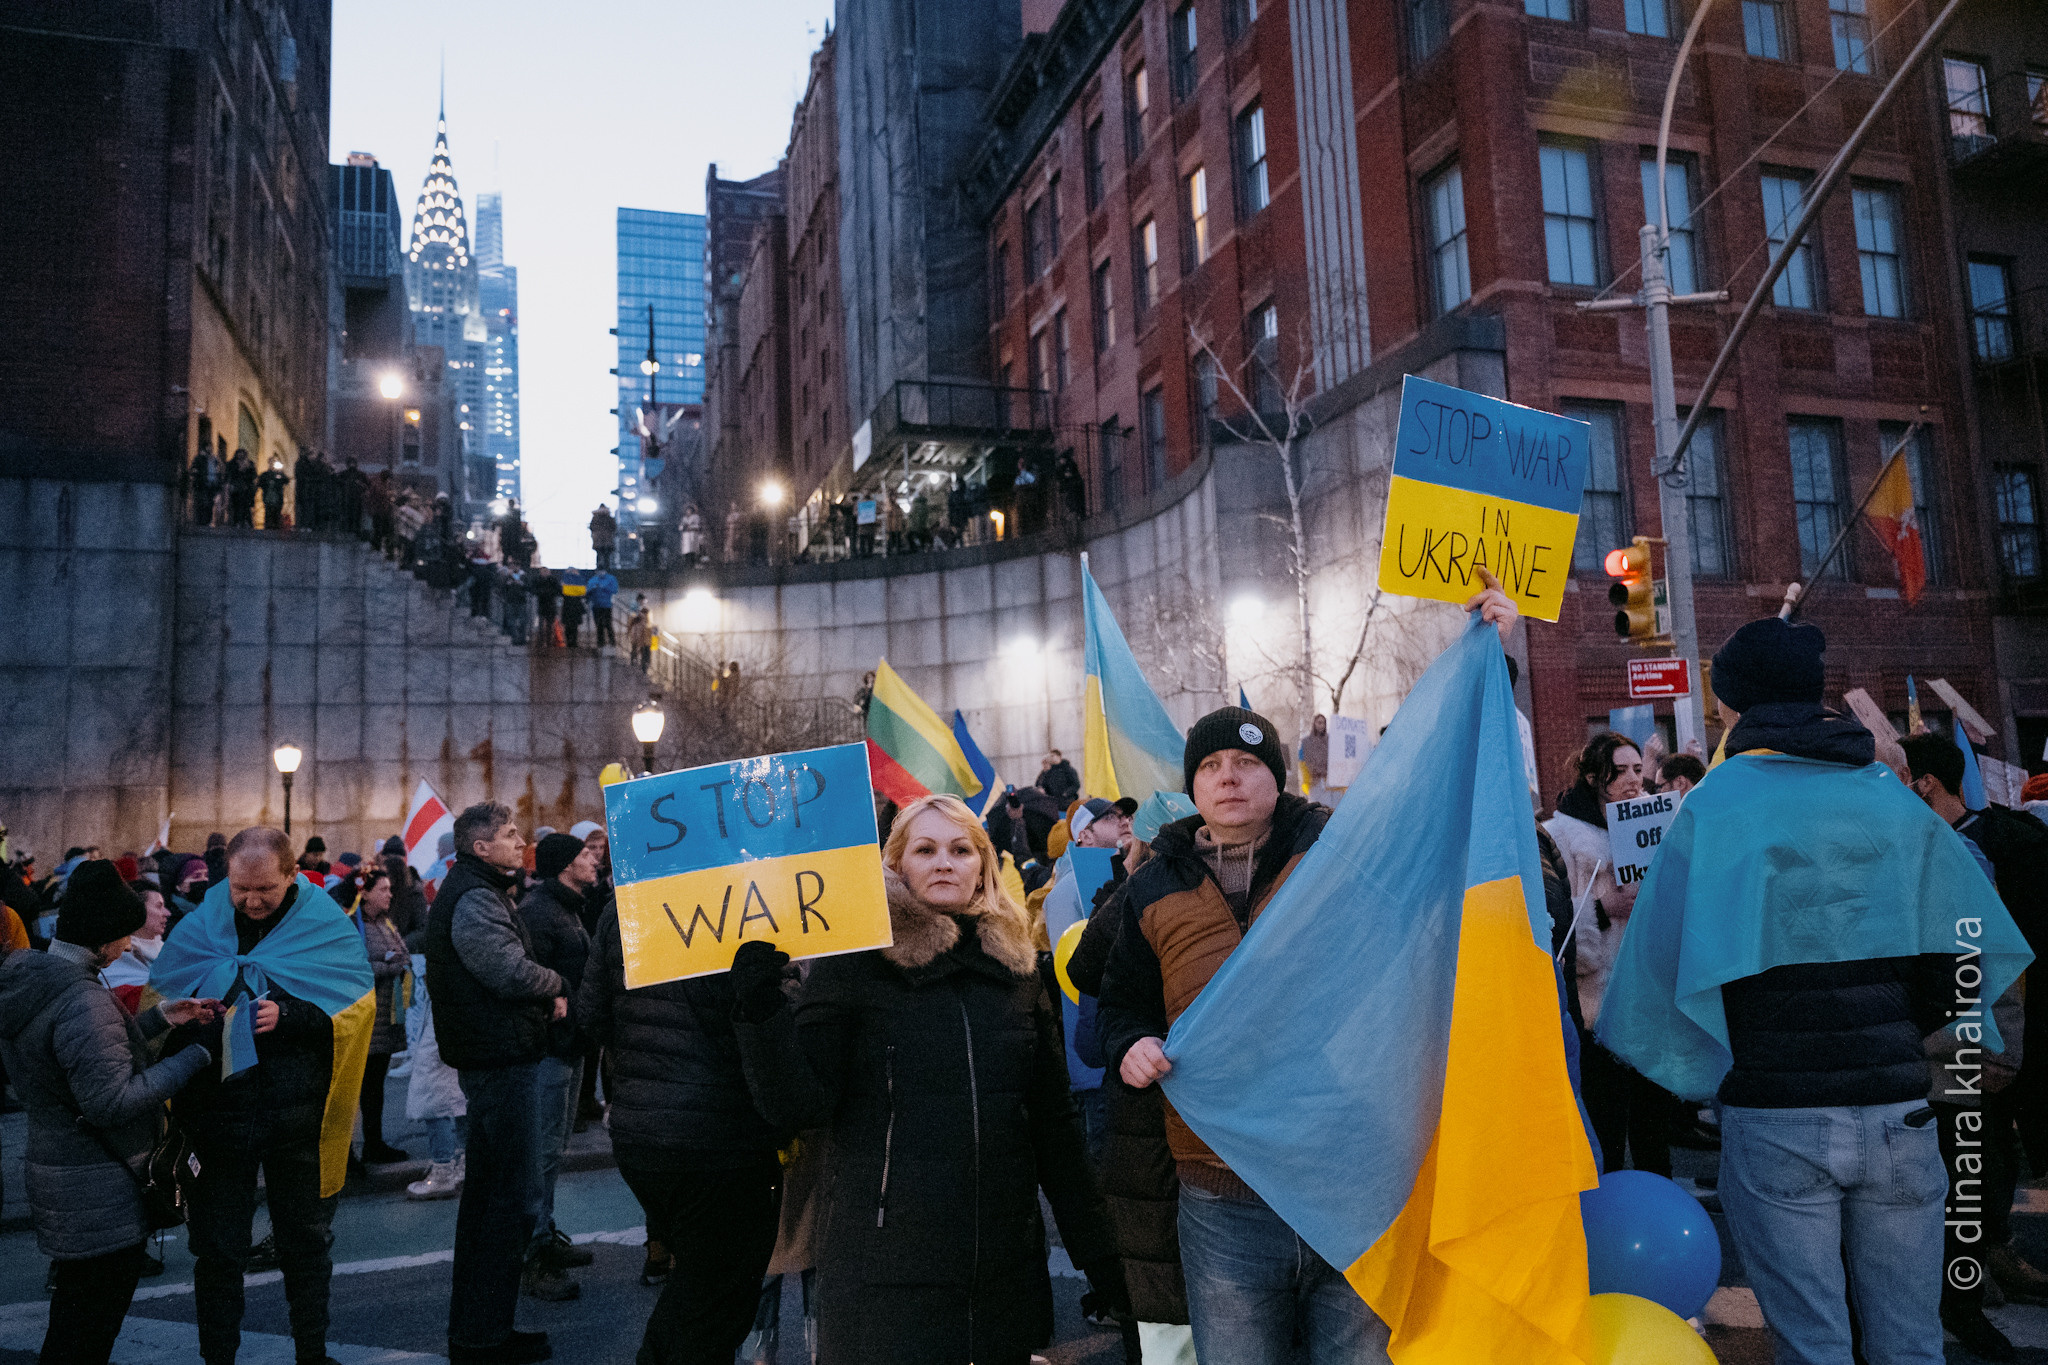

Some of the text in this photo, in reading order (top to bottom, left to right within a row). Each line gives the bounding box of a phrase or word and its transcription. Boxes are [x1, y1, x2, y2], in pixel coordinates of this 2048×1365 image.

[1410, 399, 1572, 491] STOP WAR
[1481, 506, 1510, 538] IN
[1398, 523, 1552, 598] UKRAINE
[1631, 661, 1680, 672] NO STANDING
[1632, 672, 1663, 681] Anytime
[646, 766, 827, 854] STOP
[1616, 795, 1673, 822] Hands
[1635, 826, 1662, 849] Off
[662, 870, 830, 949] WAR
